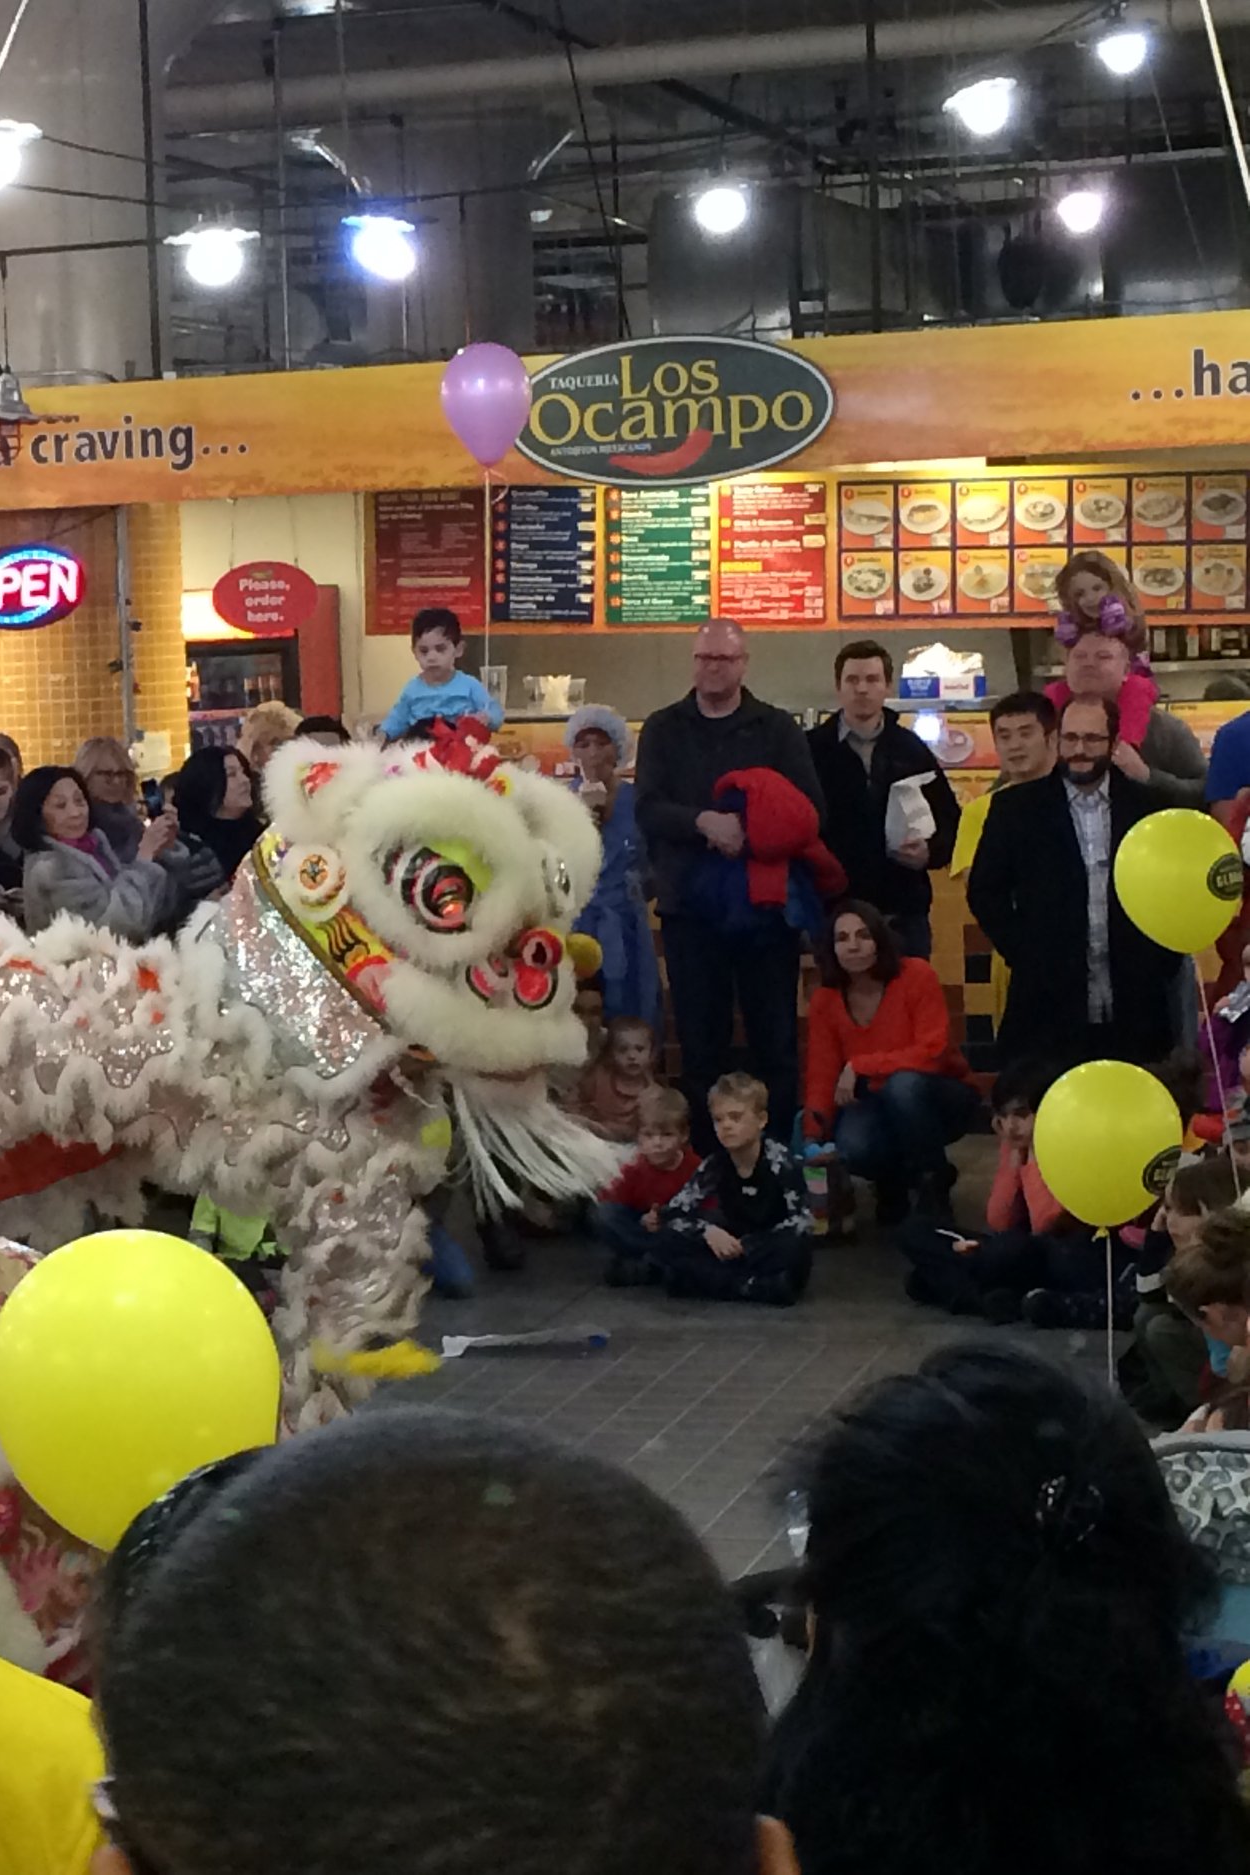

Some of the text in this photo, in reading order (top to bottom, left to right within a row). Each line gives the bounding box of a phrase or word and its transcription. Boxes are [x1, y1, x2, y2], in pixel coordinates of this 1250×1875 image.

[549, 373, 619, 390] TAQUERIA
[619, 355, 719, 399] Los
[529, 390, 814, 449] Ocampo
[244, 593, 286, 608] order
